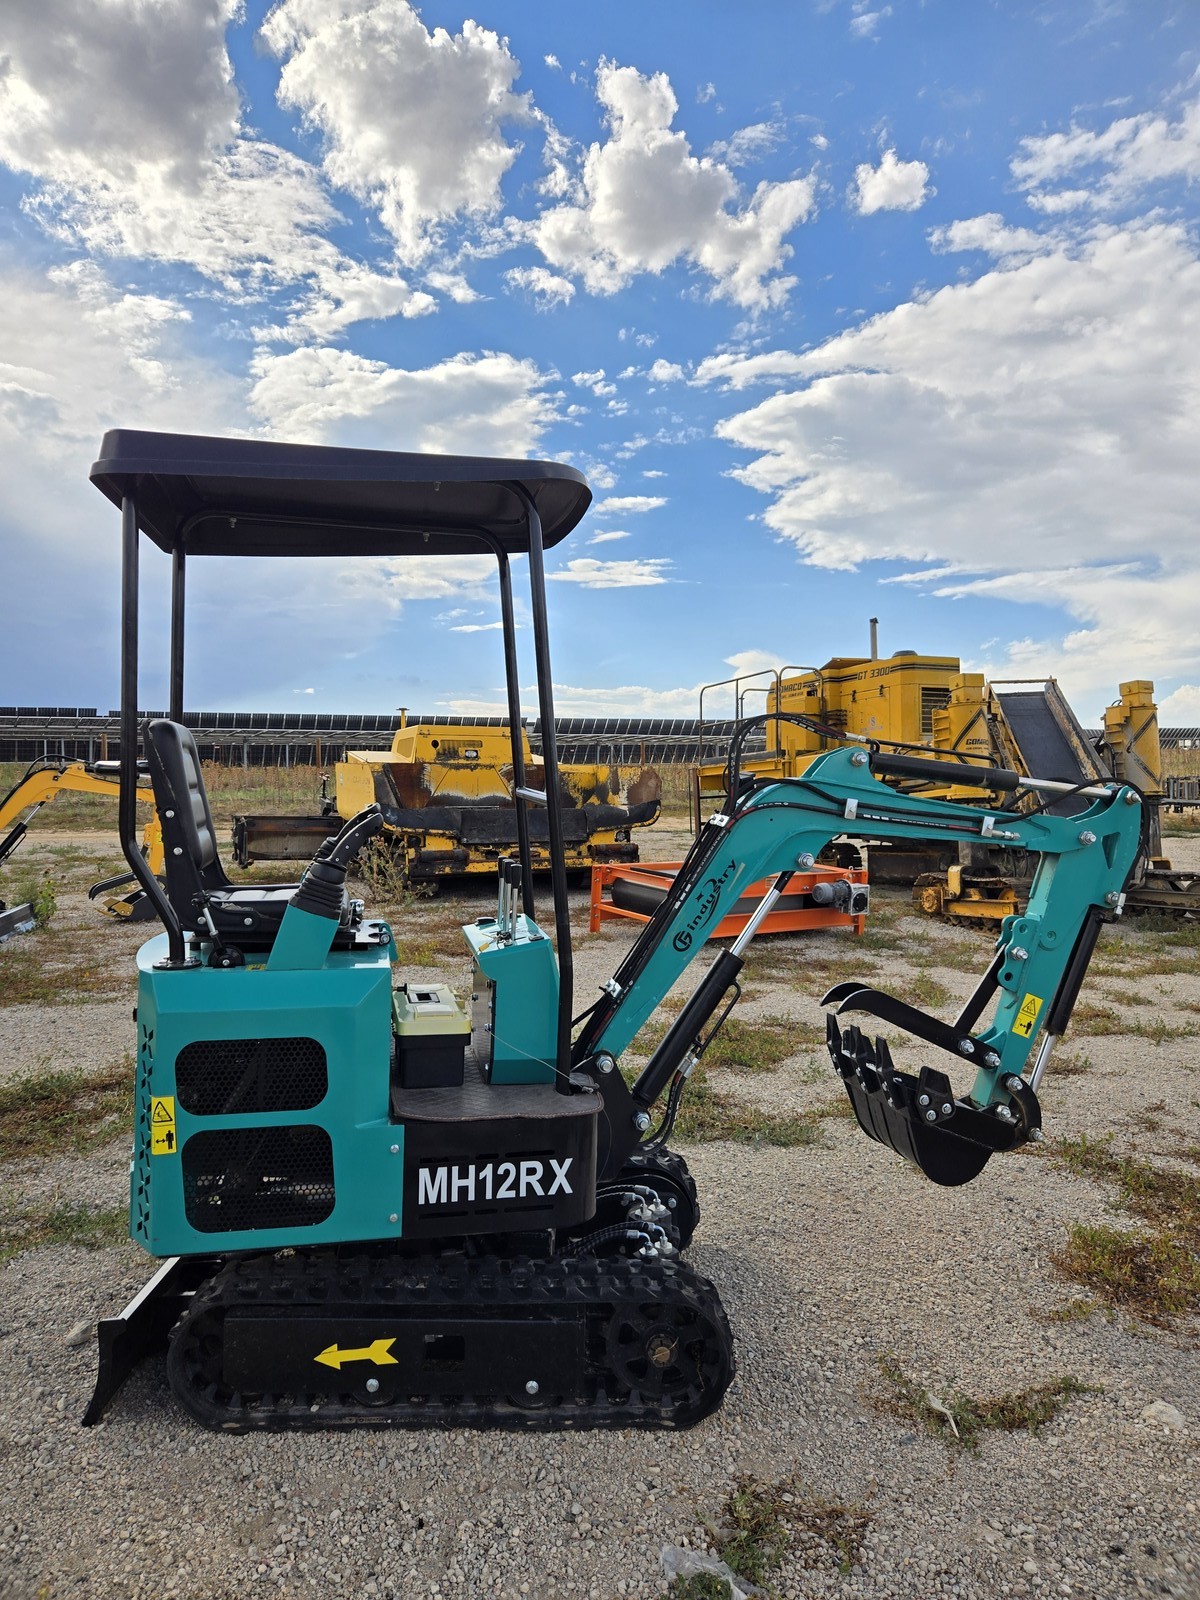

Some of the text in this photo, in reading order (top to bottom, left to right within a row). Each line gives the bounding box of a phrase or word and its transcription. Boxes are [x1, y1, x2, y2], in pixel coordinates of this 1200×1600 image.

[858, 666, 890, 680] GT 3300
[418, 1157, 574, 1205] MH12RX
